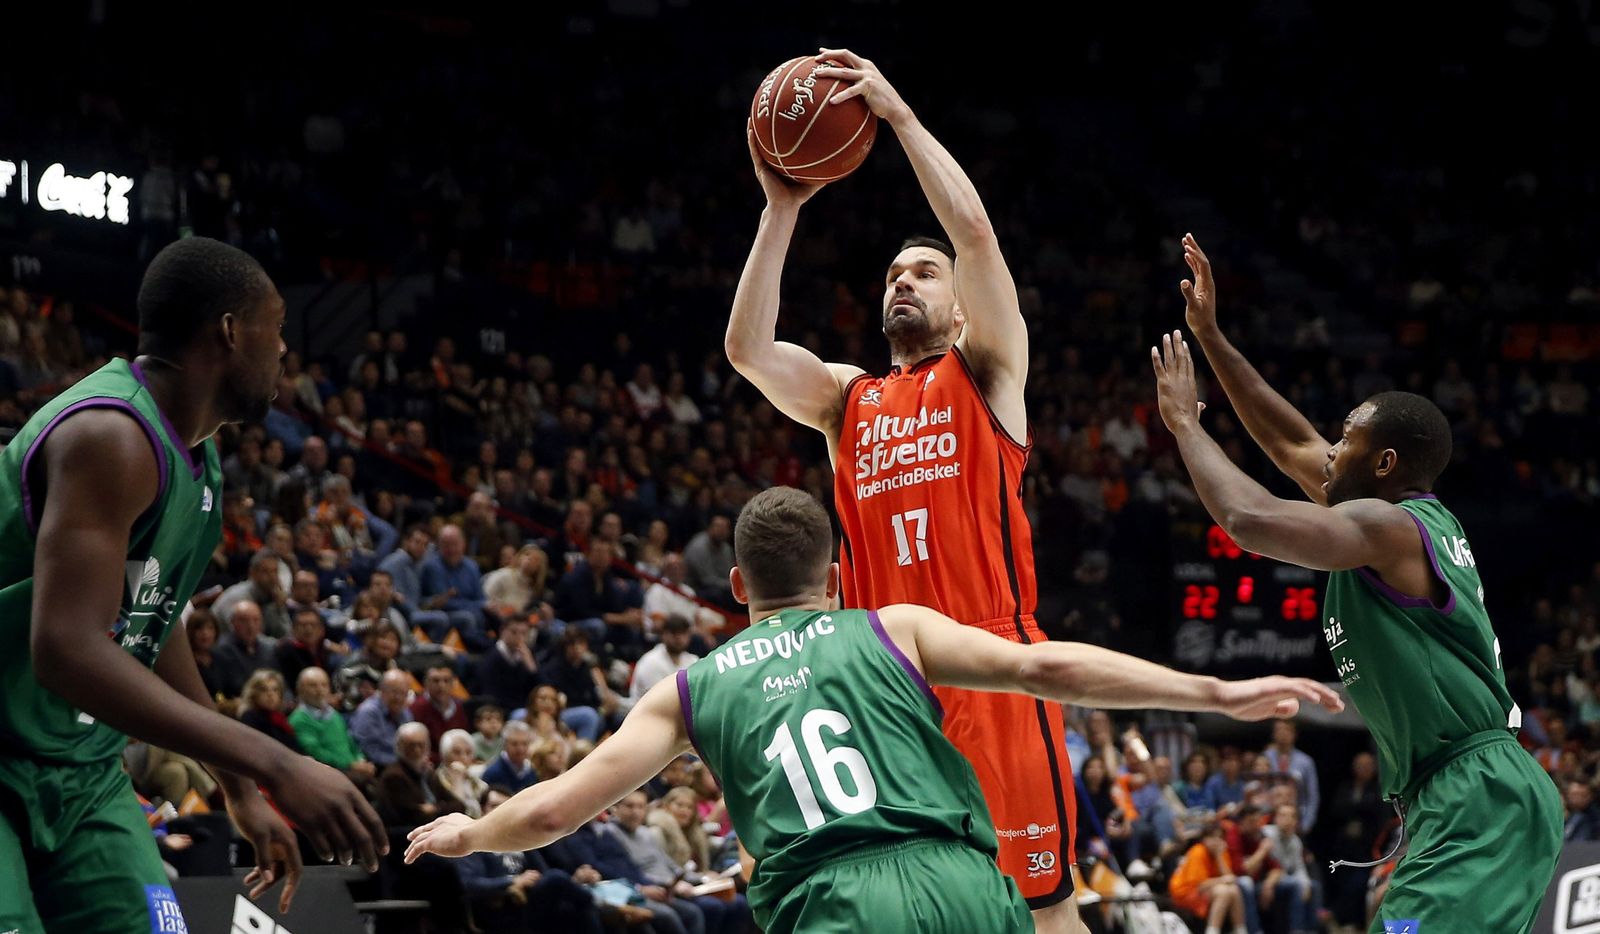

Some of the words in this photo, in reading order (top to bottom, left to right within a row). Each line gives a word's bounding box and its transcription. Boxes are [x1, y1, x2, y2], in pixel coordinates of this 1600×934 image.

[930, 406, 951, 425] del
[891, 507, 929, 566] 17
[763, 708, 877, 831] 16
[1027, 850, 1055, 871] 30
